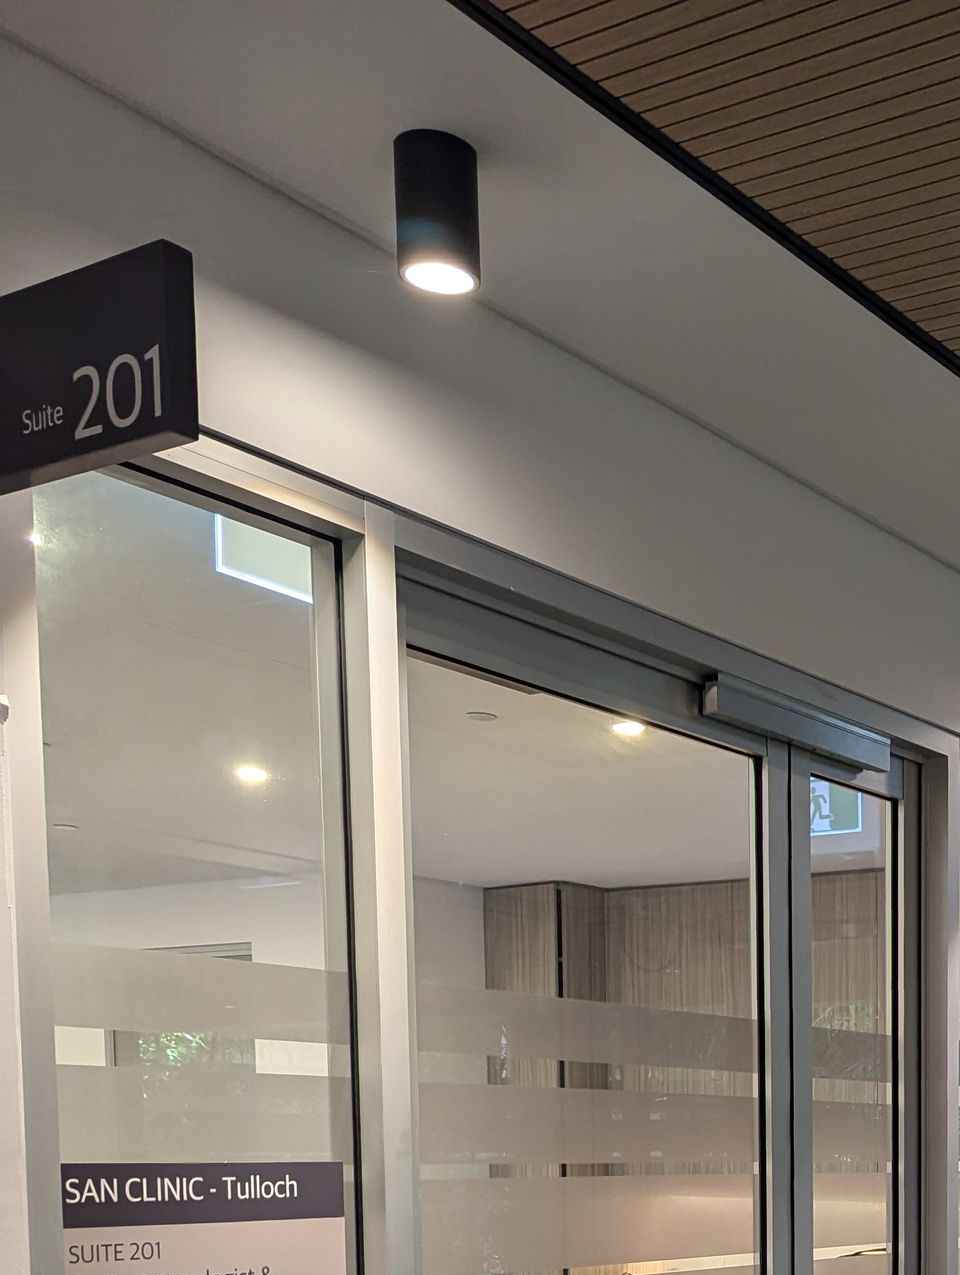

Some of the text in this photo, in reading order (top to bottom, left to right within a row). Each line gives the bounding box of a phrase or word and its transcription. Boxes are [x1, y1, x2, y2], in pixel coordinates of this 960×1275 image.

[22, 344, 162, 440] Suite 201
[65, 1177, 119, 1204] SAN
[124, 1176, 204, 1203] CLINIC
[222, 1174, 298, 1200] Tulloch
[68, 1241, 161, 1264] SUITE 201
